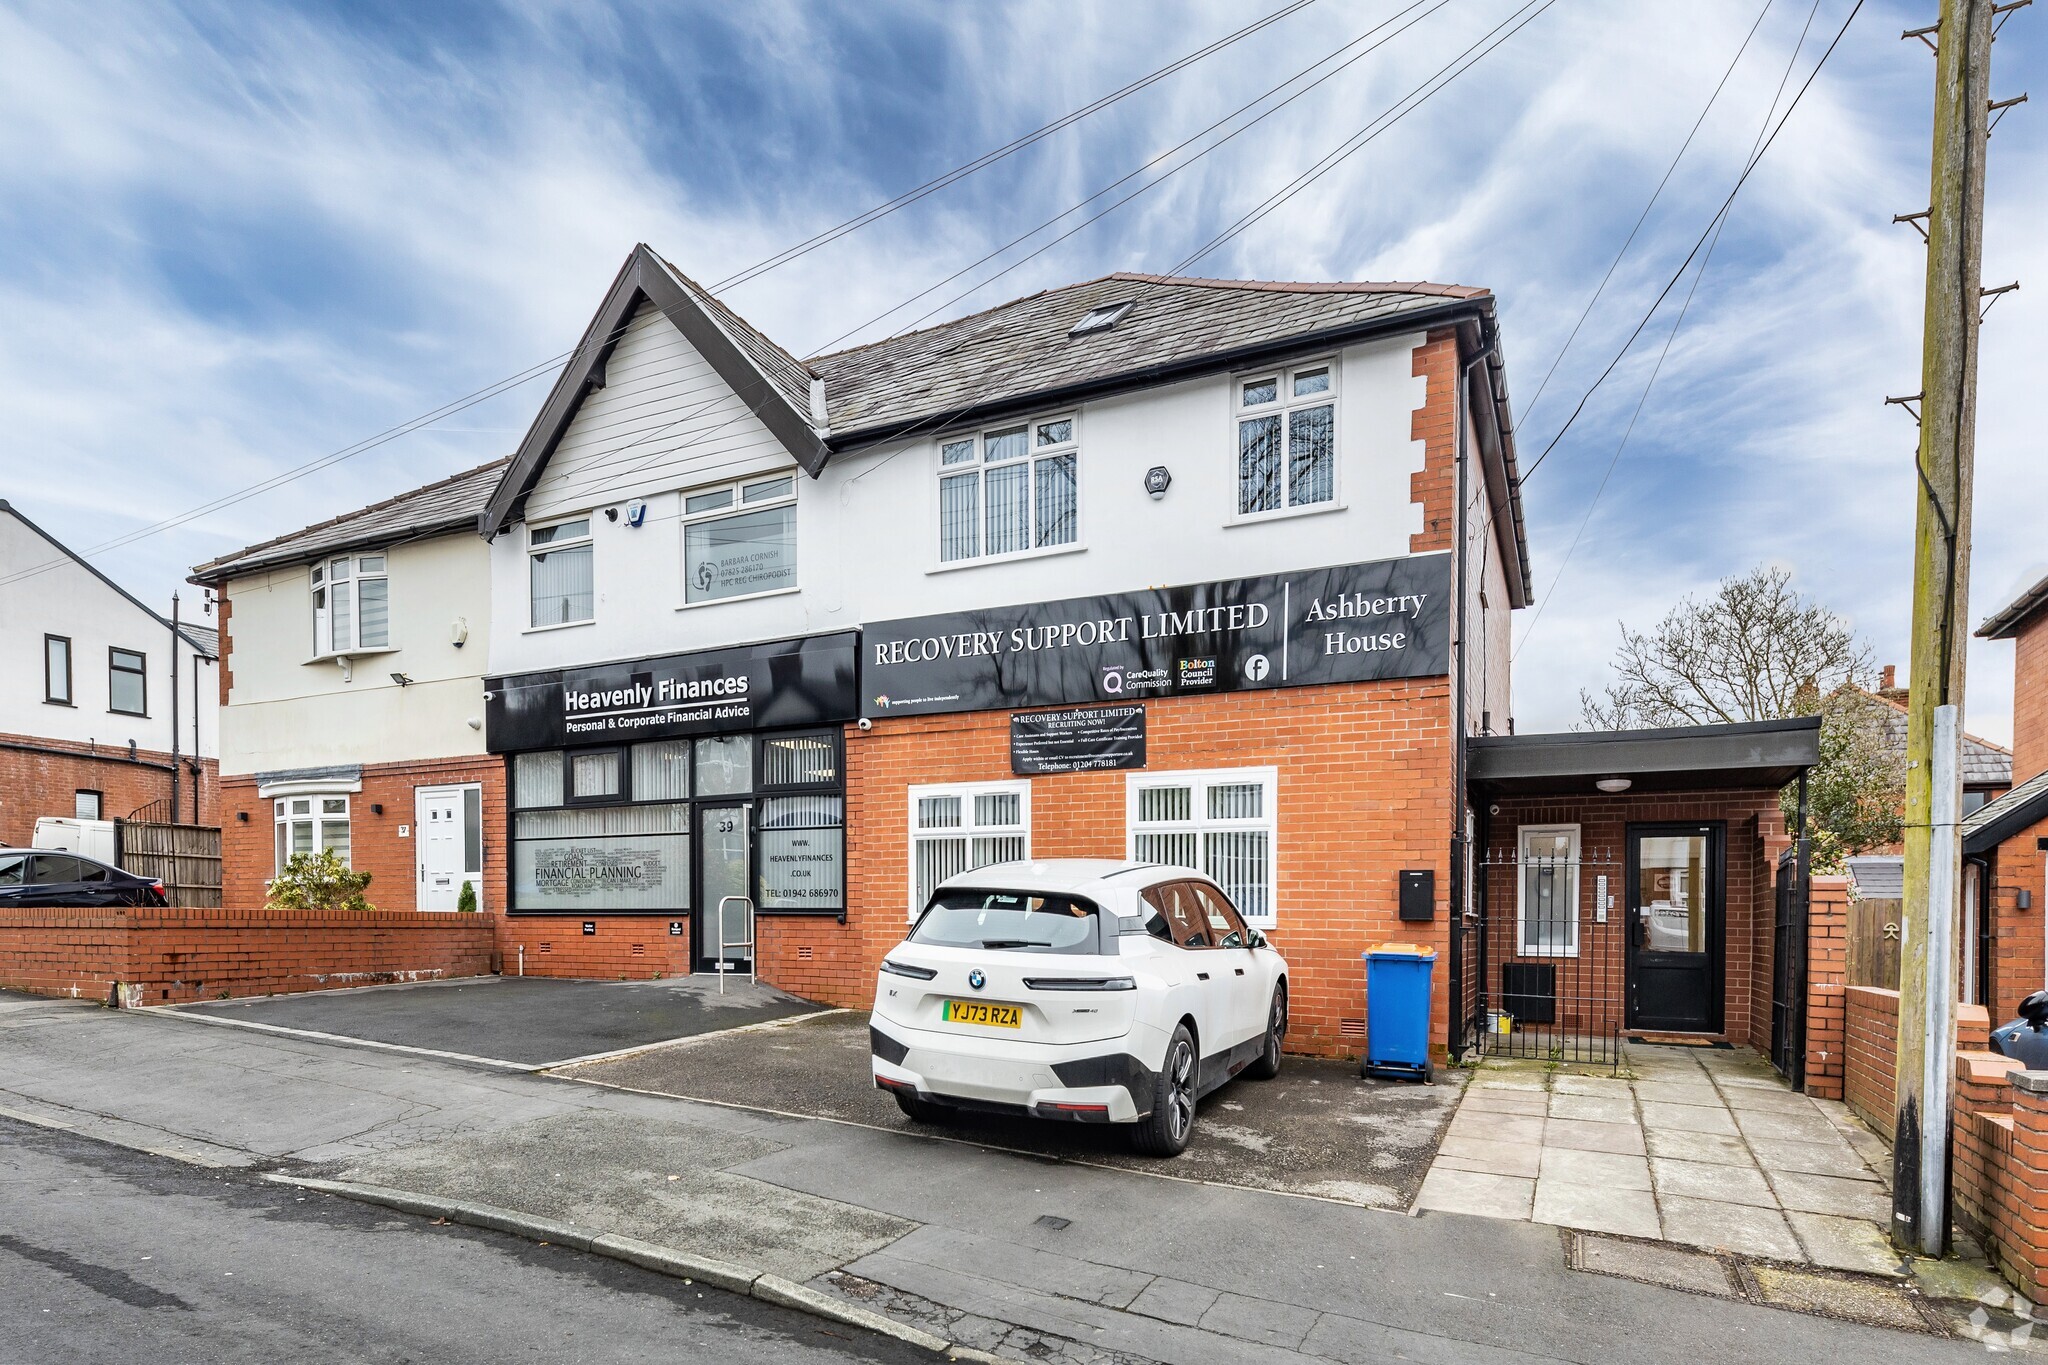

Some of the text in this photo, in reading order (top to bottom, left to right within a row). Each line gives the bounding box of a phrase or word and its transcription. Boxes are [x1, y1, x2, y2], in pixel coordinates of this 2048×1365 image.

[721, 550, 779, 567] BARBARA CORNISH
[721, 568, 791, 587] HPC REG CHIROPODIST
[1305, 592, 1427, 623] Ashberry
[875, 603, 1269, 665] RECOVERY SUPPORT LIMITED
[1325, 632, 1406, 655] House
[1180, 659, 1215, 670] Bolton
[1126, 669, 1168, 679] CareQuality
[1181, 668, 1213, 678] Council
[1126, 679, 1172, 690] Commission
[1181, 677, 1212, 686] Provider
[565, 675, 749, 711] Heavenly Finances
[566, 705, 749, 733] Personal & Corporate Financial Advice
[1020, 707, 1135, 723] RECOVERY SUPPORT LIMITED
[1048, 719, 1086, 728] RECRUITING
[1038, 759, 1116, 771] Telephone: 01204 778181
[719, 821, 733, 833] 39
[770, 854, 833, 863] HEAVENLYFINANCES
[536, 867, 586, 879] FINANCIAL
[590, 866, 642, 879] PLANNING
[766, 889, 838, 898] TEL: 01942 686970
[953, 1003, 1018, 1026] YJ73 RZA
